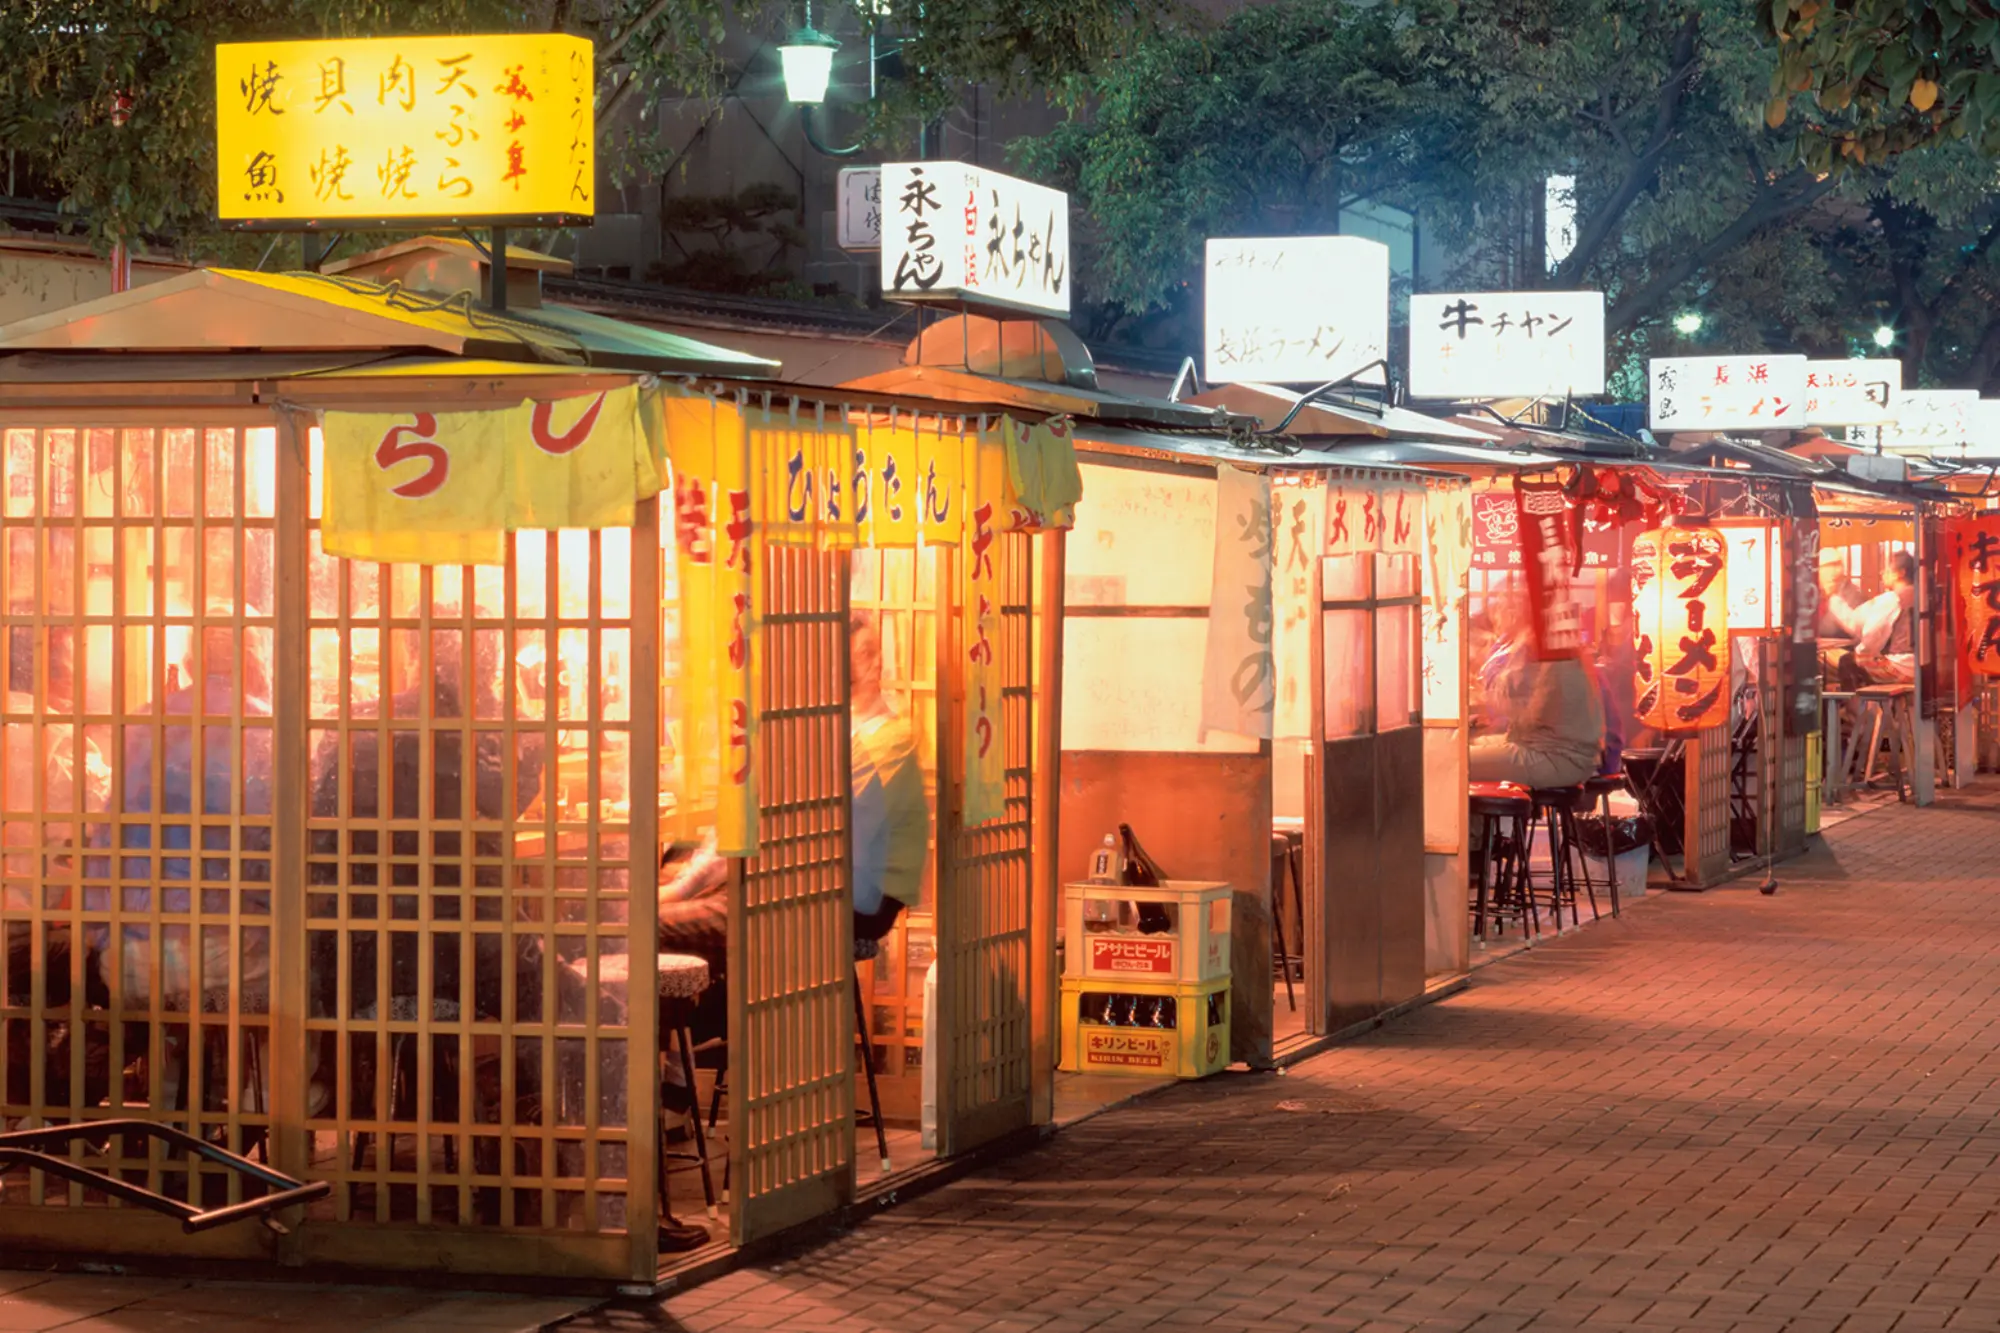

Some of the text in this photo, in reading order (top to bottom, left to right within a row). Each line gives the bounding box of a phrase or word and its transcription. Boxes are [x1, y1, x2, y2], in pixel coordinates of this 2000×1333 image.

[893, 167, 944, 292] 永ちゃん
[985, 189, 1065, 295] 永ちゃん
[1439, 299, 1573, 340] 牛チャン
[1712, 364, 1770, 387] 長浜
[1700, 396, 1792, 419] ラーメン
[788, 450, 950, 524] ひょうたん
[1664, 539, 1723, 721] ラーメン
[1095, 942, 1170, 959] アサヒビール
[1091, 1036, 1158, 1051] キリンビール
